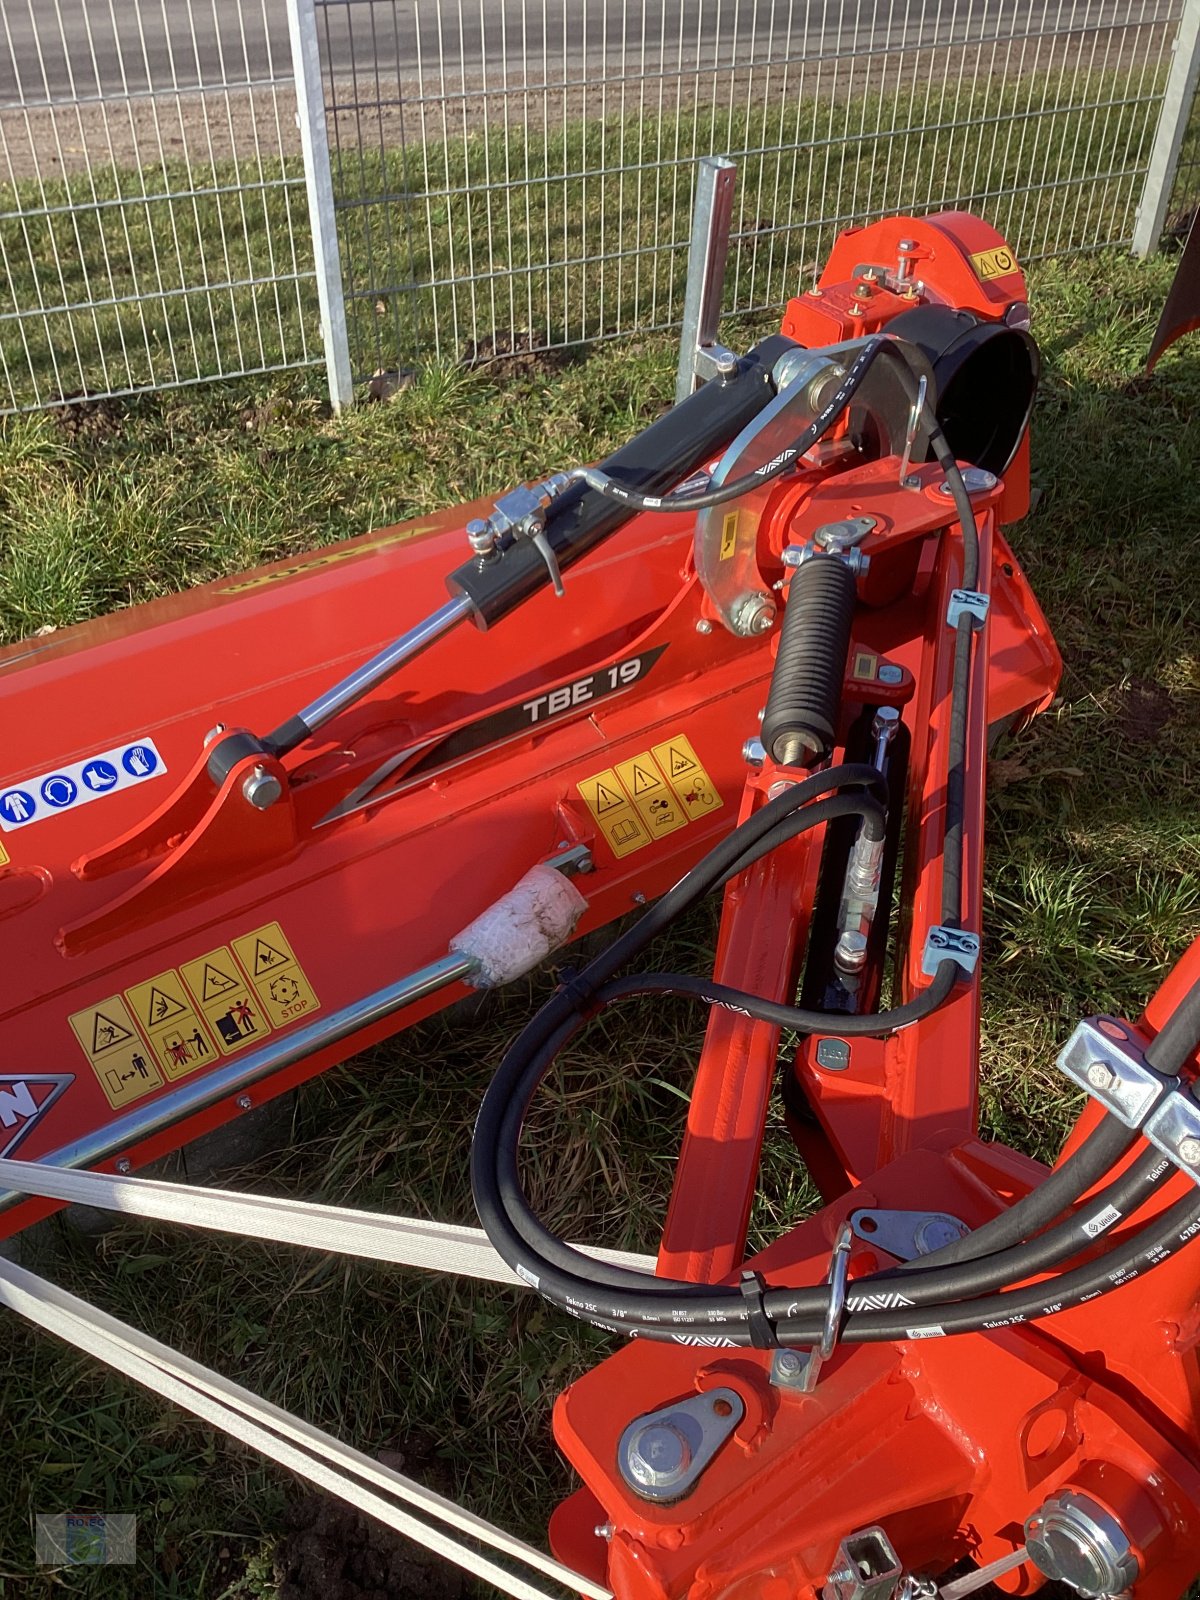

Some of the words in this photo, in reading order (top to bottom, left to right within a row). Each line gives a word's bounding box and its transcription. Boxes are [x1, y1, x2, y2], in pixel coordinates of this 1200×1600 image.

[523, 676, 593, 722] TBE
[608, 658, 642, 689] 19
[281, 1000, 308, 1019] STOP
[1146, 1160, 1169, 1182] Tekno
[1099, 1212, 1118, 1227] Vitillo
[1180, 1222, 1200, 1241] 4780
[565, 1295, 584, 1309] Tekno
[584, 1302, 598, 1313] 2SC
[983, 1320, 1010, 1329] Tekno
[1010, 1314, 1027, 1324] 2SC
[1042, 1302, 1063, 1315] 3/8"
